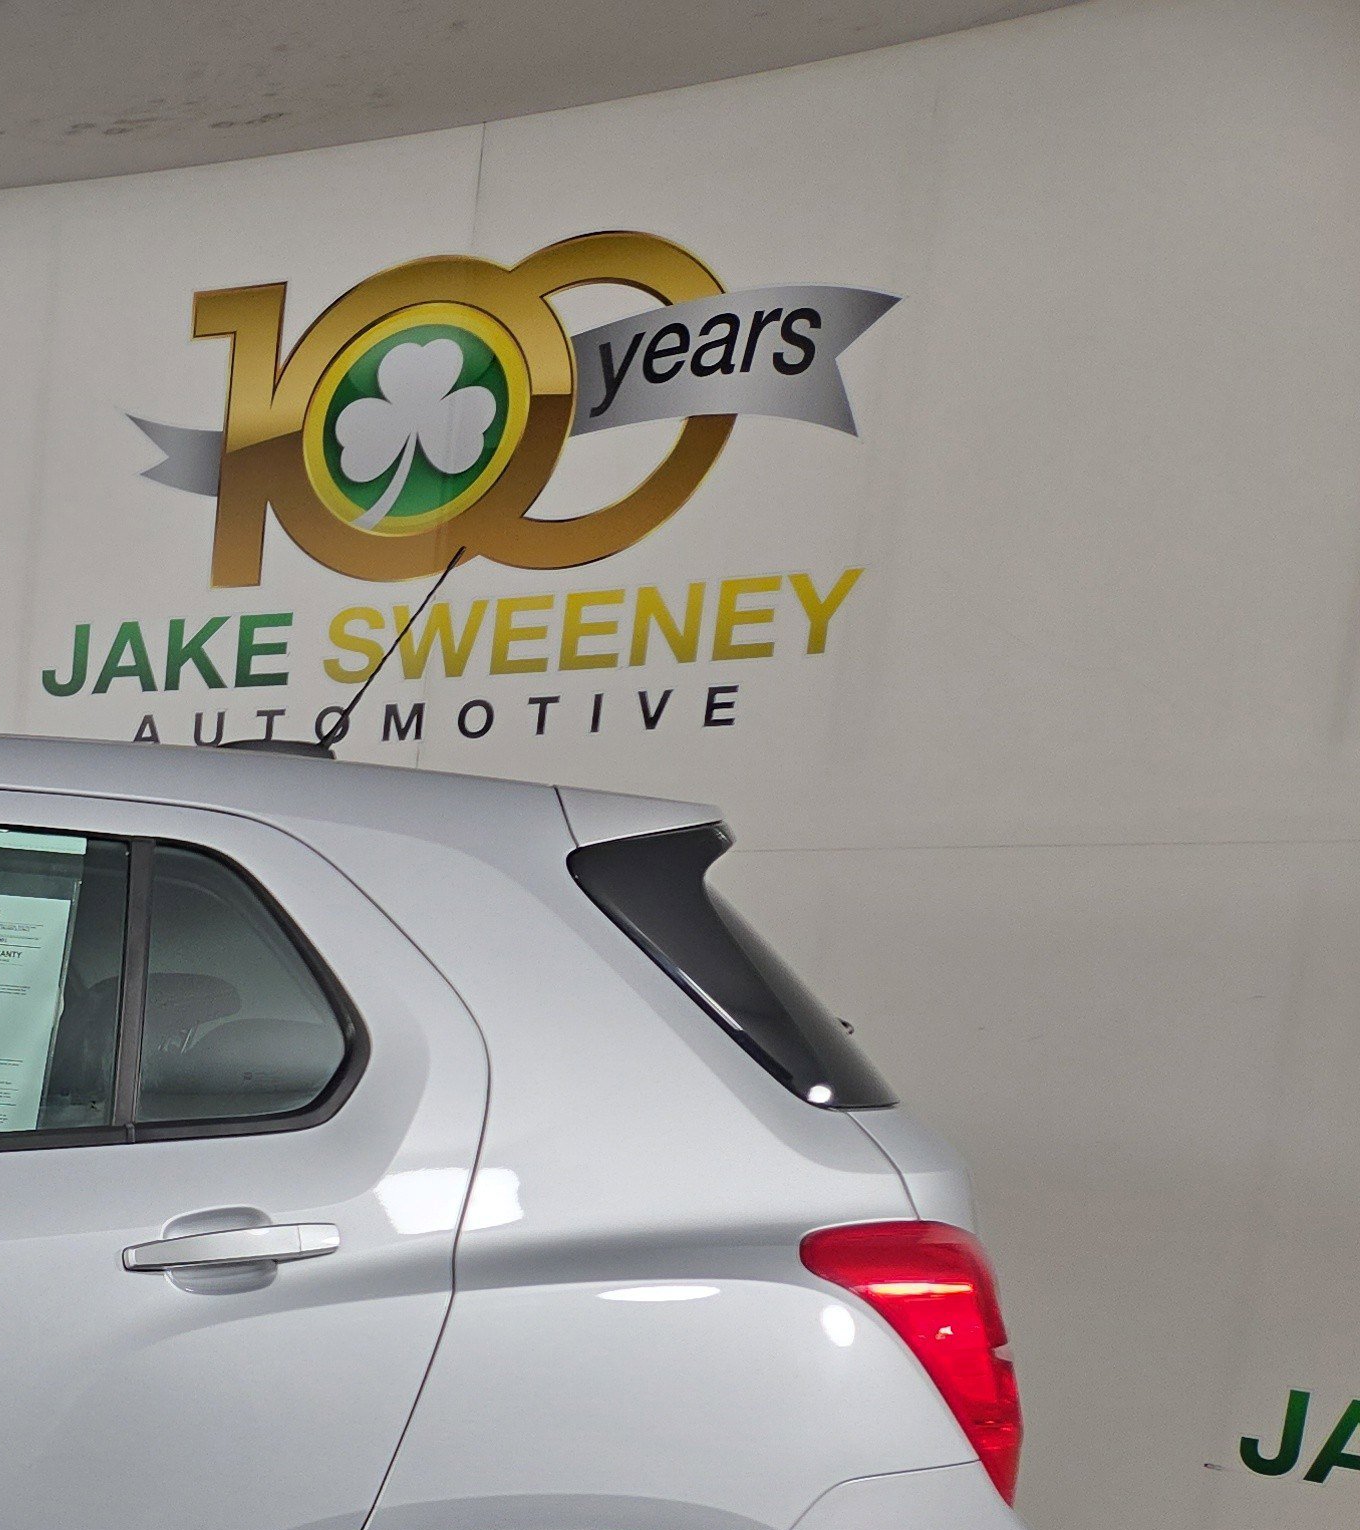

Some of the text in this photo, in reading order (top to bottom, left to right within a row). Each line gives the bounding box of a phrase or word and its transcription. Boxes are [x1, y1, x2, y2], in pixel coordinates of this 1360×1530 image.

[192, 230, 738, 588] 100
[588, 304, 824, 418] years
[41, 568, 866, 698] JAKE SWEENEY
[132, 684, 740, 746] AUTOMOTIVE
